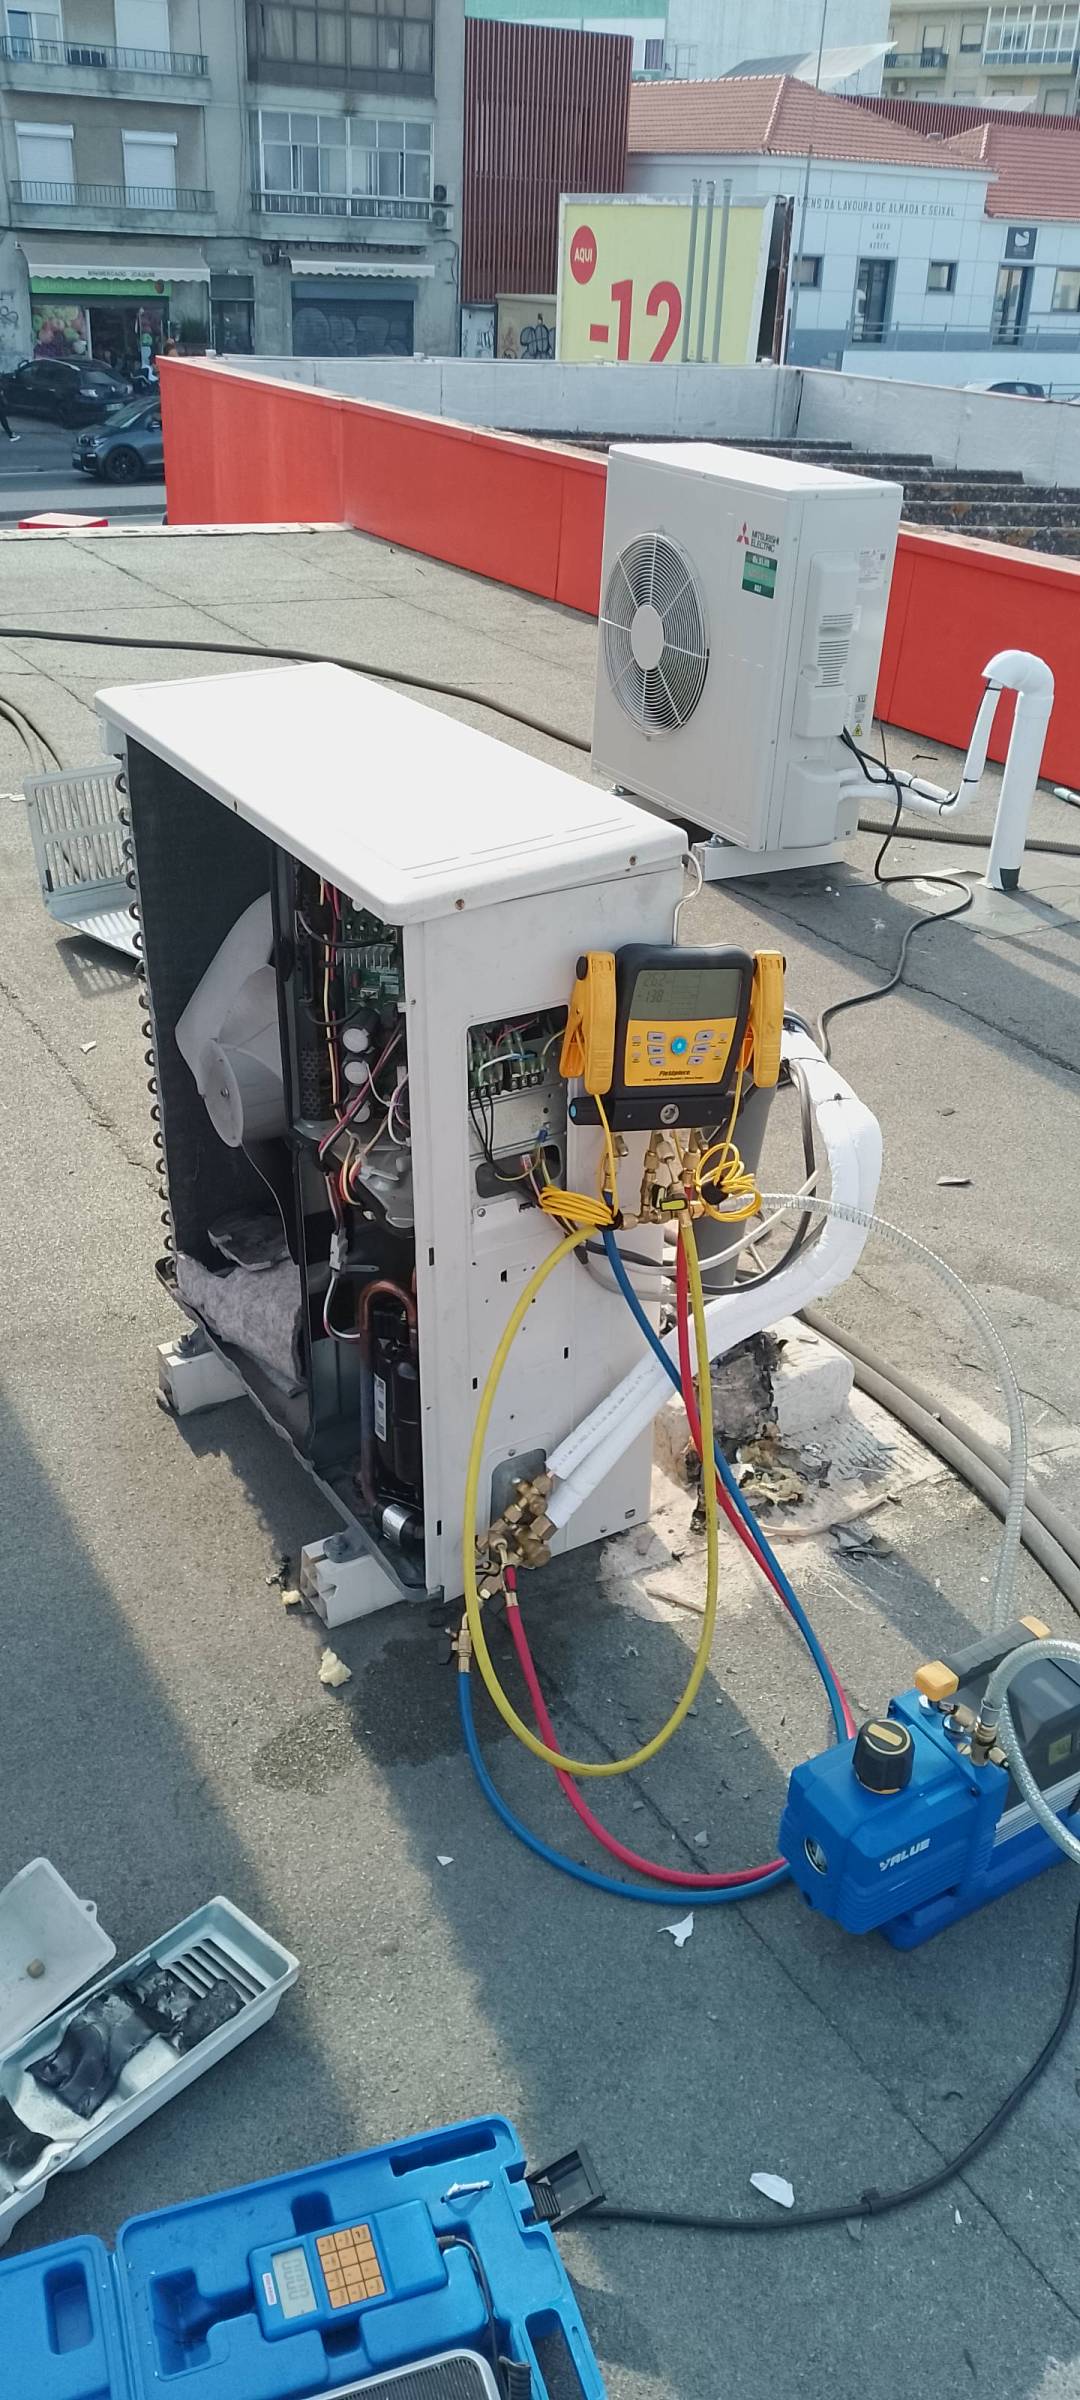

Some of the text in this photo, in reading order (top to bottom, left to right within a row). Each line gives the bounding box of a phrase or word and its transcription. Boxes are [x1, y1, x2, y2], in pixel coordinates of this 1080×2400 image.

[824, 198, 835, 209] DA
[837, 199, 873, 212] LAVOURA
[875, 201, 887, 213] DE
[889, 202, 919, 215] ALMADA
[929, 204, 955, 217] SEIXAL
[574, 247, 593, 263] AQUI
[751, 529, 780, 545] MITSUBISHI
[750, 538, 776, 553] ELECTRIC
[879, 1837, 931, 1872] VALUE
